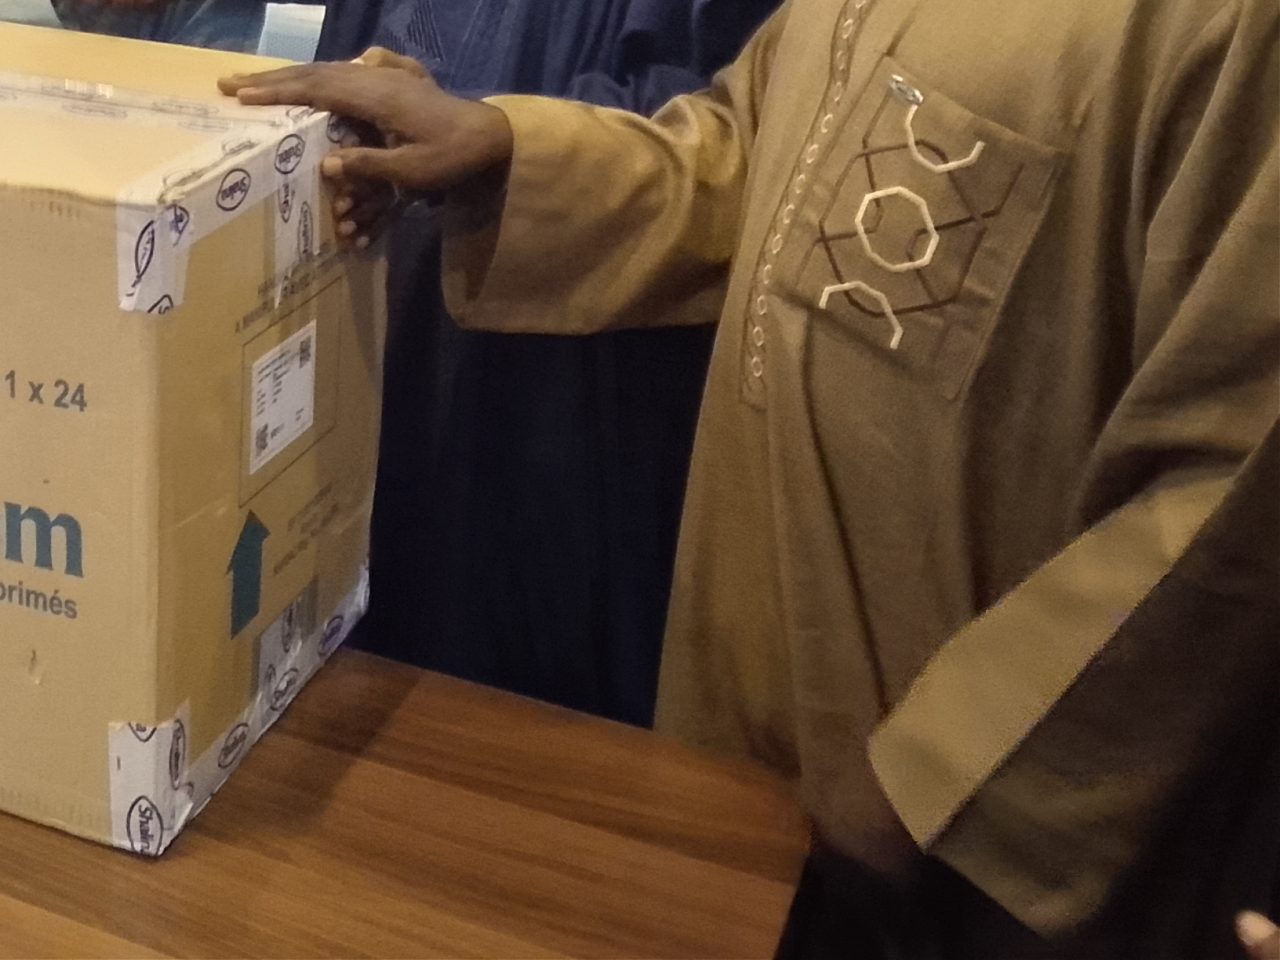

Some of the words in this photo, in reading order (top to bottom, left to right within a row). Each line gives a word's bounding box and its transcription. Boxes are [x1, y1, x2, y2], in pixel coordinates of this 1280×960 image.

[4, 369, 16, 399] 1
[28, 381, 44, 405] x
[53, 379, 88, 412] 24
